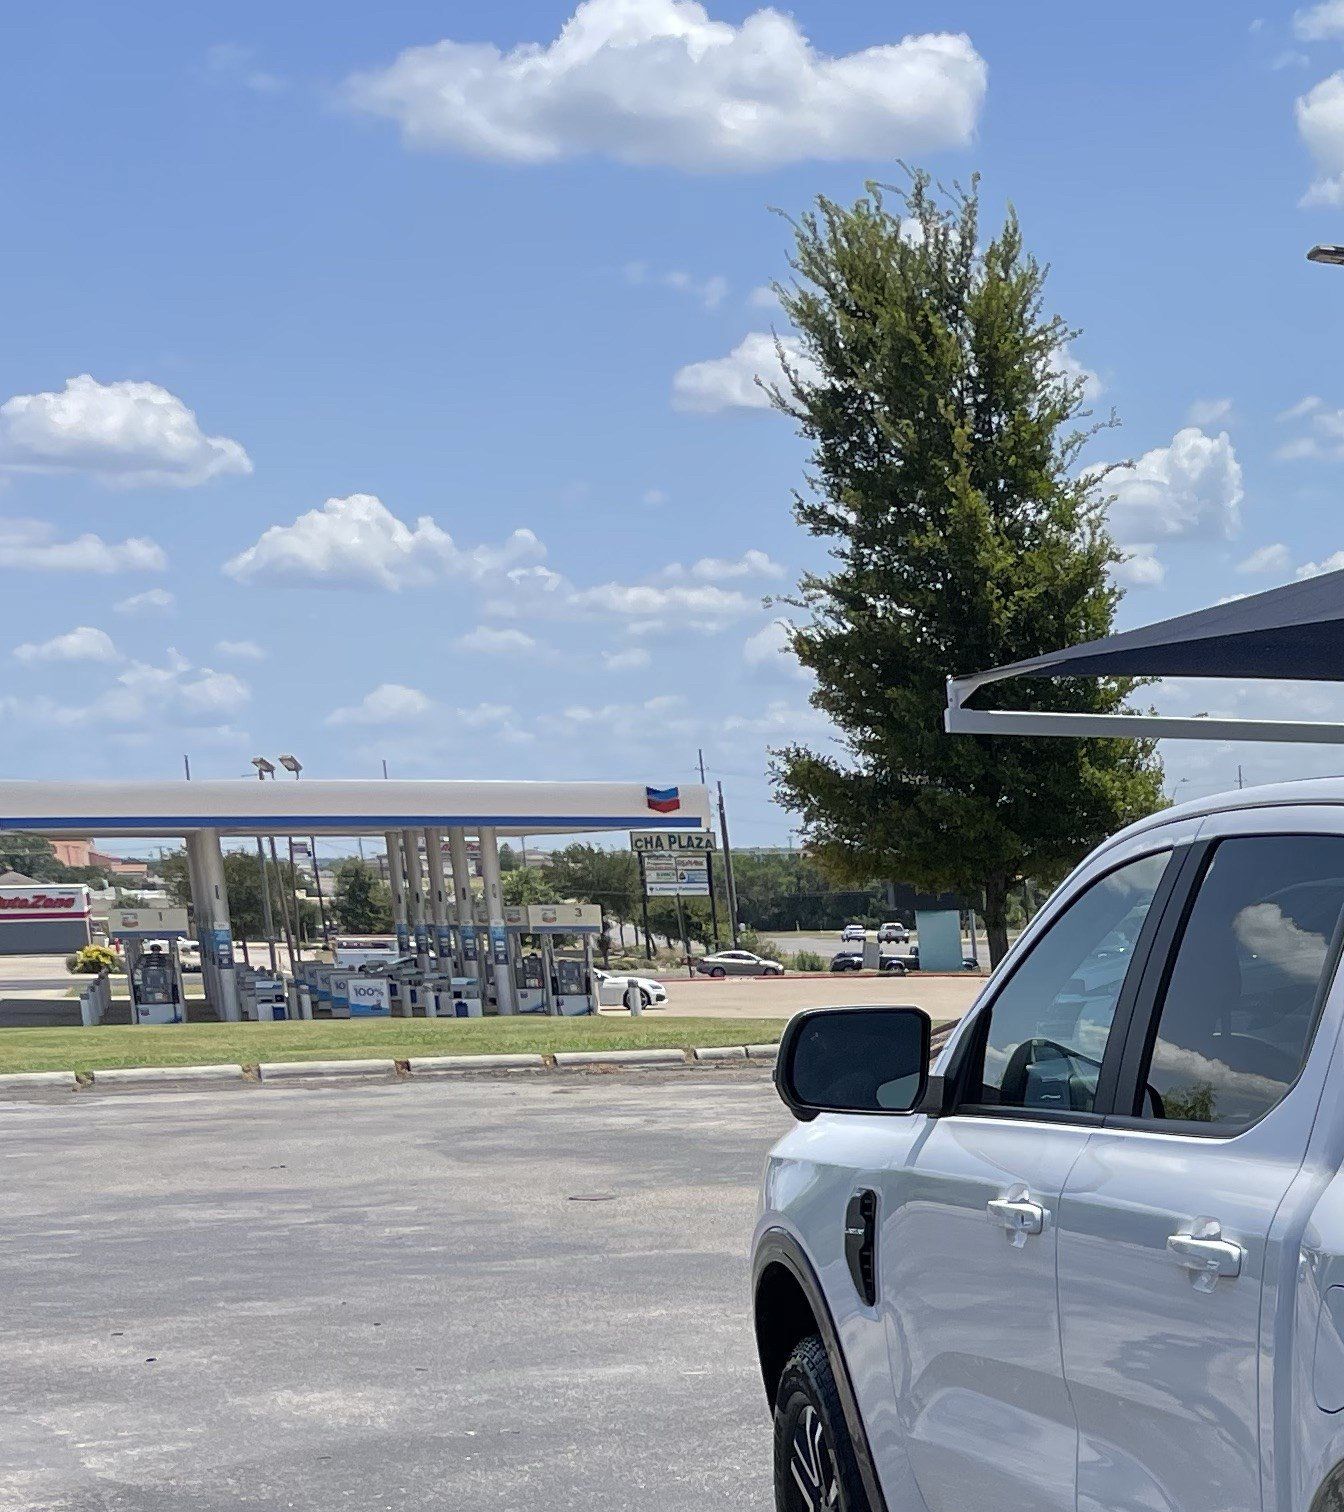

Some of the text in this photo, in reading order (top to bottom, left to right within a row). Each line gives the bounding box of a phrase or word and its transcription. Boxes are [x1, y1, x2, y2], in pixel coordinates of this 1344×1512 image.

[634, 834, 713, 850] CHA PLAZA
[354, 987, 384, 997] 100%
